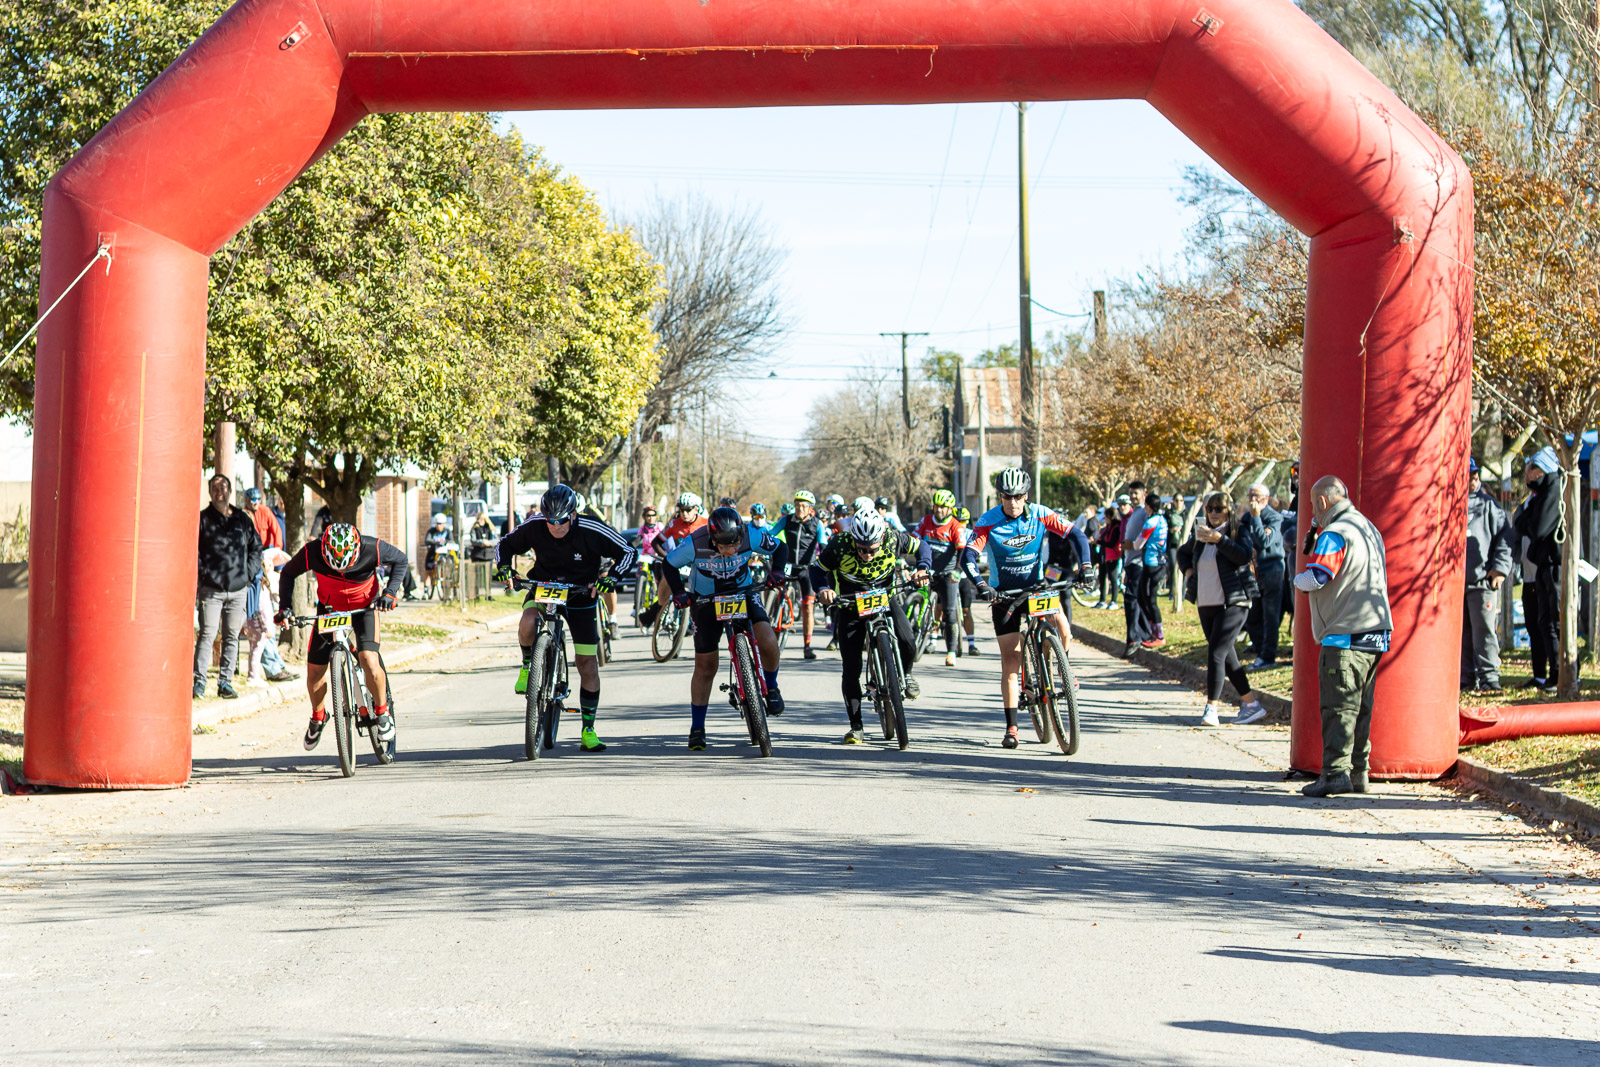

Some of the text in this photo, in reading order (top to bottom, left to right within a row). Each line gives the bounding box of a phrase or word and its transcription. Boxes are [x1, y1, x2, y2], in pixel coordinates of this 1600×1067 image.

[541, 587, 563, 598] 35
[720, 600, 743, 614] 167
[864, 595, 882, 609] 93
[1036, 598, 1051, 610] 51
[323, 616, 348, 628] 160
